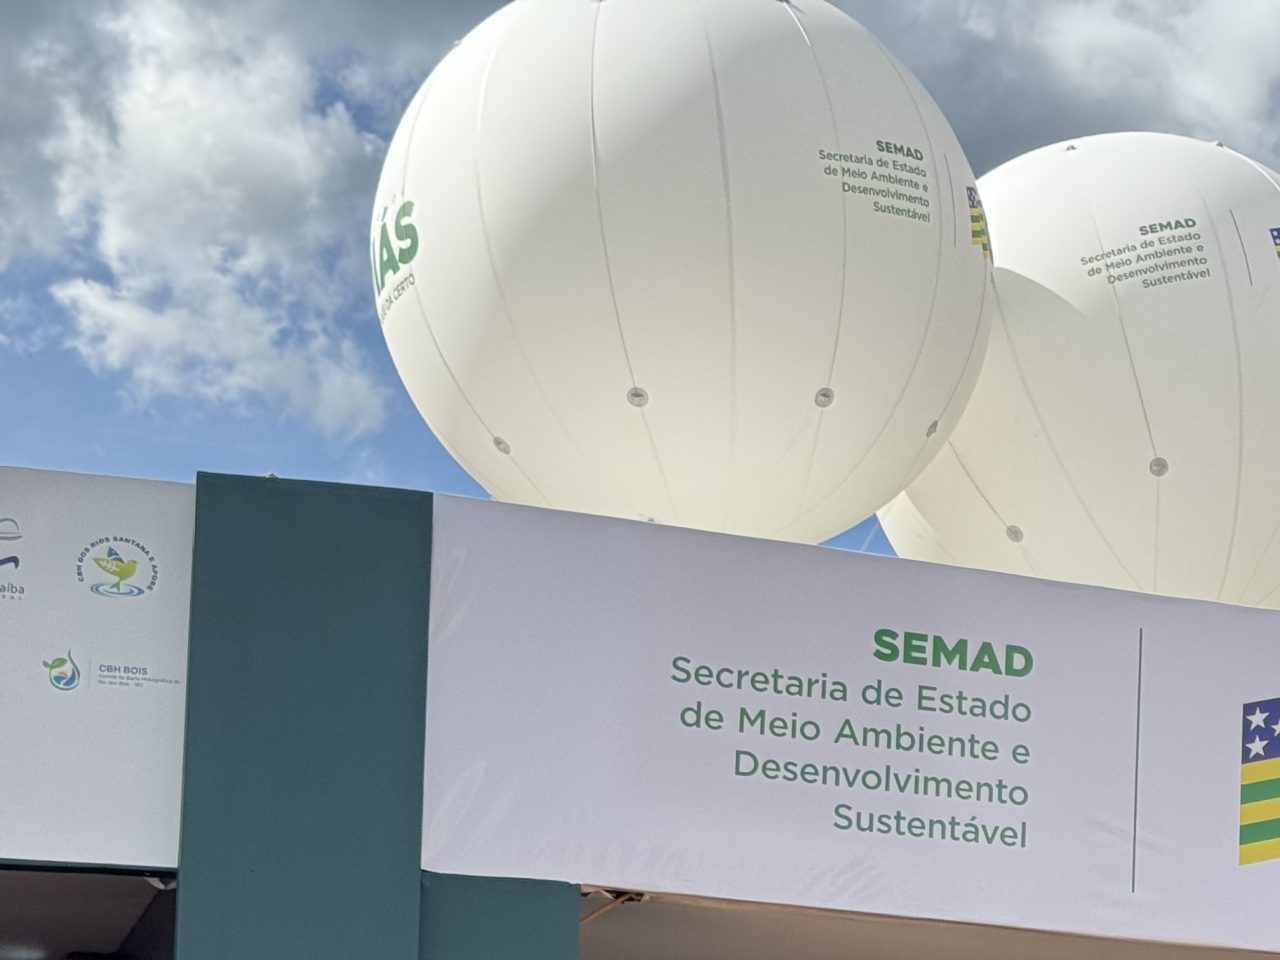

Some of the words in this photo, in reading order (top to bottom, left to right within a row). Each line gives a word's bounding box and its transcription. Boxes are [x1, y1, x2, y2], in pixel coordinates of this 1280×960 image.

[819, 149, 873, 166] Secretaria
[876, 158, 889, 168] de
[892, 160, 926, 177] Estado
[876, 140, 923, 161] SEMAD
[824, 165, 838, 176] de
[841, 167, 867, 179] Meio
[871, 171, 920, 190] Ambiente
[922, 184, 928, 192] e
[842, 182, 929, 207] Desenvolvimento
[873, 201, 930, 223] Sustentável
[1139, 218, 1196, 236] SEMAD
[373, 200, 419, 296] ÁS
[1080, 243, 1137, 266] Secretaria
[1140, 239, 1155, 250] de
[1158, 232, 1200, 246] Estado
[1087, 263, 1102, 278] de
[1105, 256, 1134, 273] Meio
[1136, 243, 1193, 264] Ambiente
[1196, 244, 1204, 253] e
[1107, 256, 1207, 285] Desenvolvimento
[1142, 268, 1211, 289] Sustentável
[873, 628, 1034, 677] SEMAD
[99, 664, 120, 673] CBH
[123, 666, 148, 675] BOIS
[670, 656, 849, 702] Secretaria
[861, 679, 903, 707] de
[917, 684, 1032, 723] Estado
[680, 701, 724, 729] de
[738, 707, 821, 742] Meio
[834, 718, 999, 762] Ambiente
[1011, 744, 1031, 765] e
[734, 750, 1029, 806] Desenvolvimento
[833, 803, 1027, 848] Sustentável
